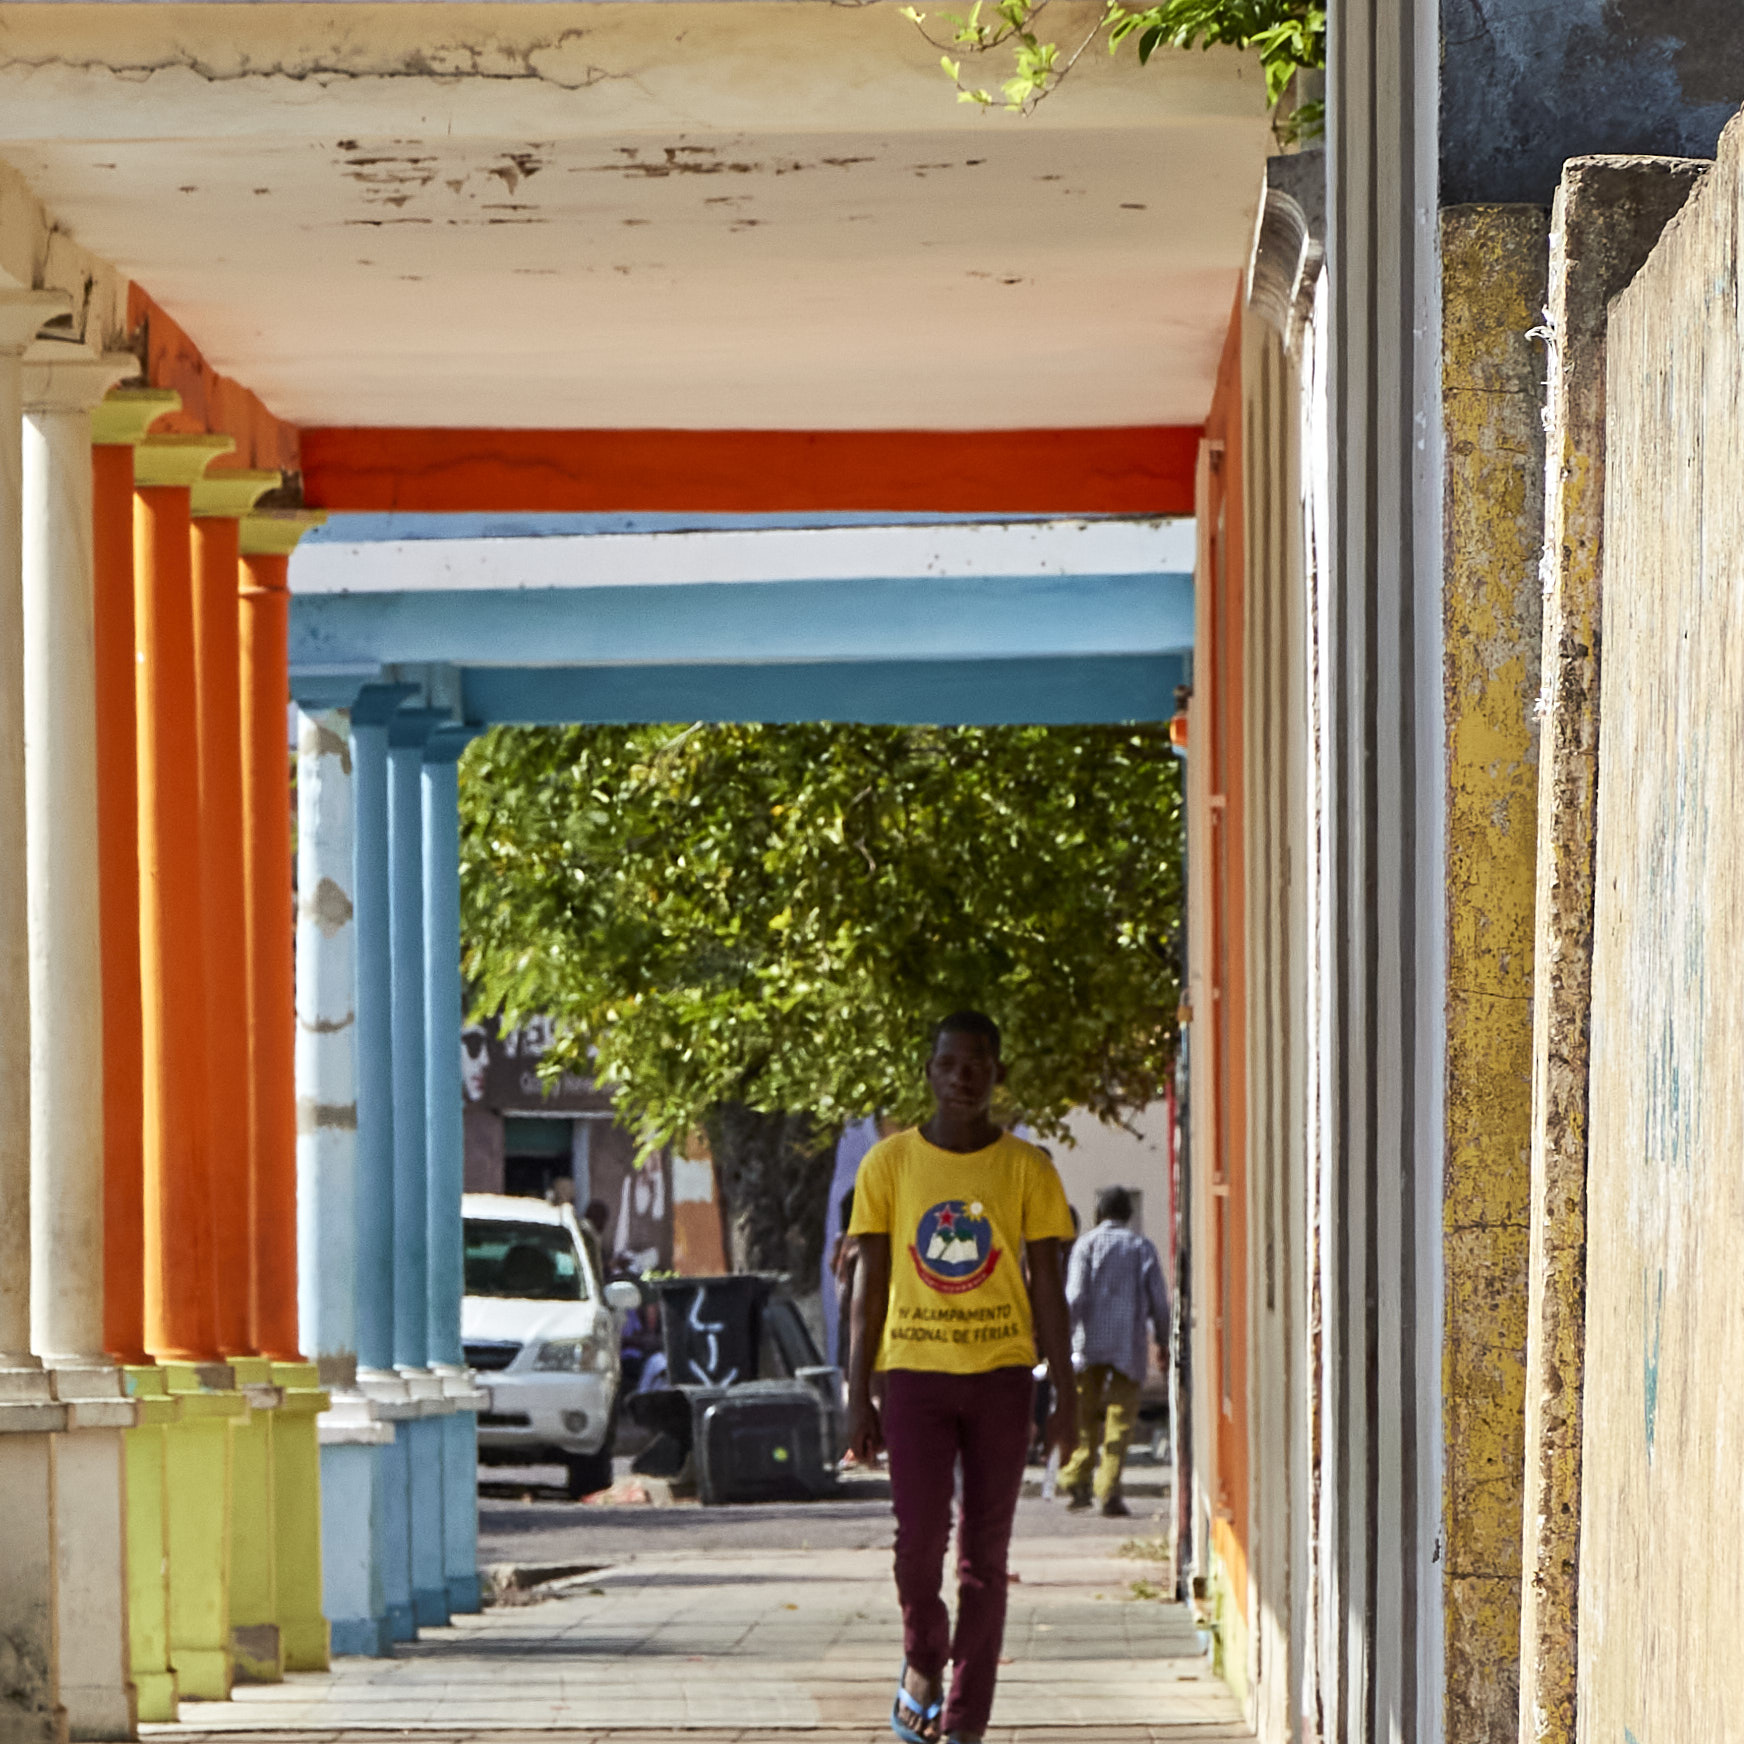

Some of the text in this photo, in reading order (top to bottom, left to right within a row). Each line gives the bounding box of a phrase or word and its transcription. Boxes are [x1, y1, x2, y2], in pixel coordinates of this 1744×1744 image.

[912, 1304, 1011, 1321] ACAMPAMENTO
[891, 1327, 948, 1343] NACIONAL
[953, 1328, 969, 1344] DE
